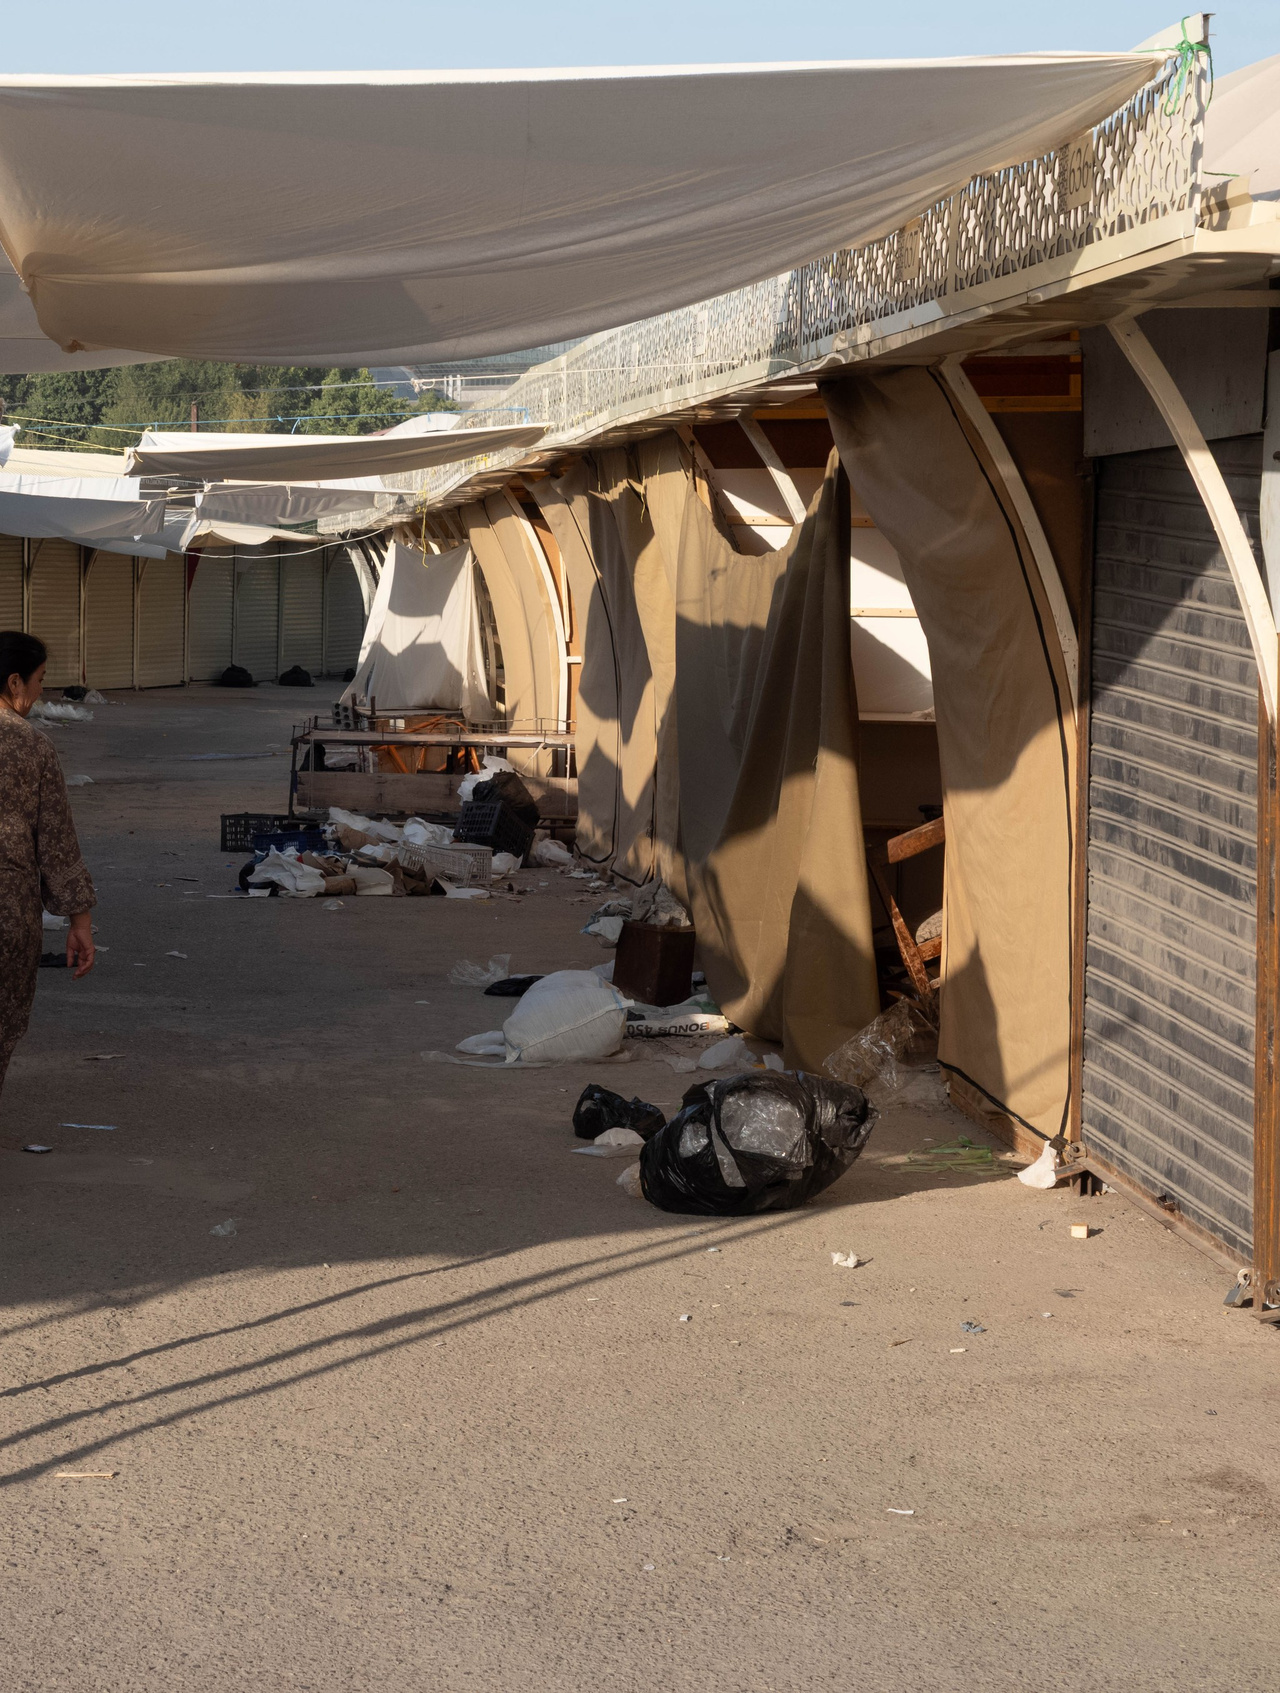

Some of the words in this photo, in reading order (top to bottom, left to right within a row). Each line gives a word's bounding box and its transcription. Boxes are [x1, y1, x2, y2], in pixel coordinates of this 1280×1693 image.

[1068, 142, 1090, 195] 636
[626, 1023, 654, 1036] 450
[657, 1021, 710, 1035] BONUS
